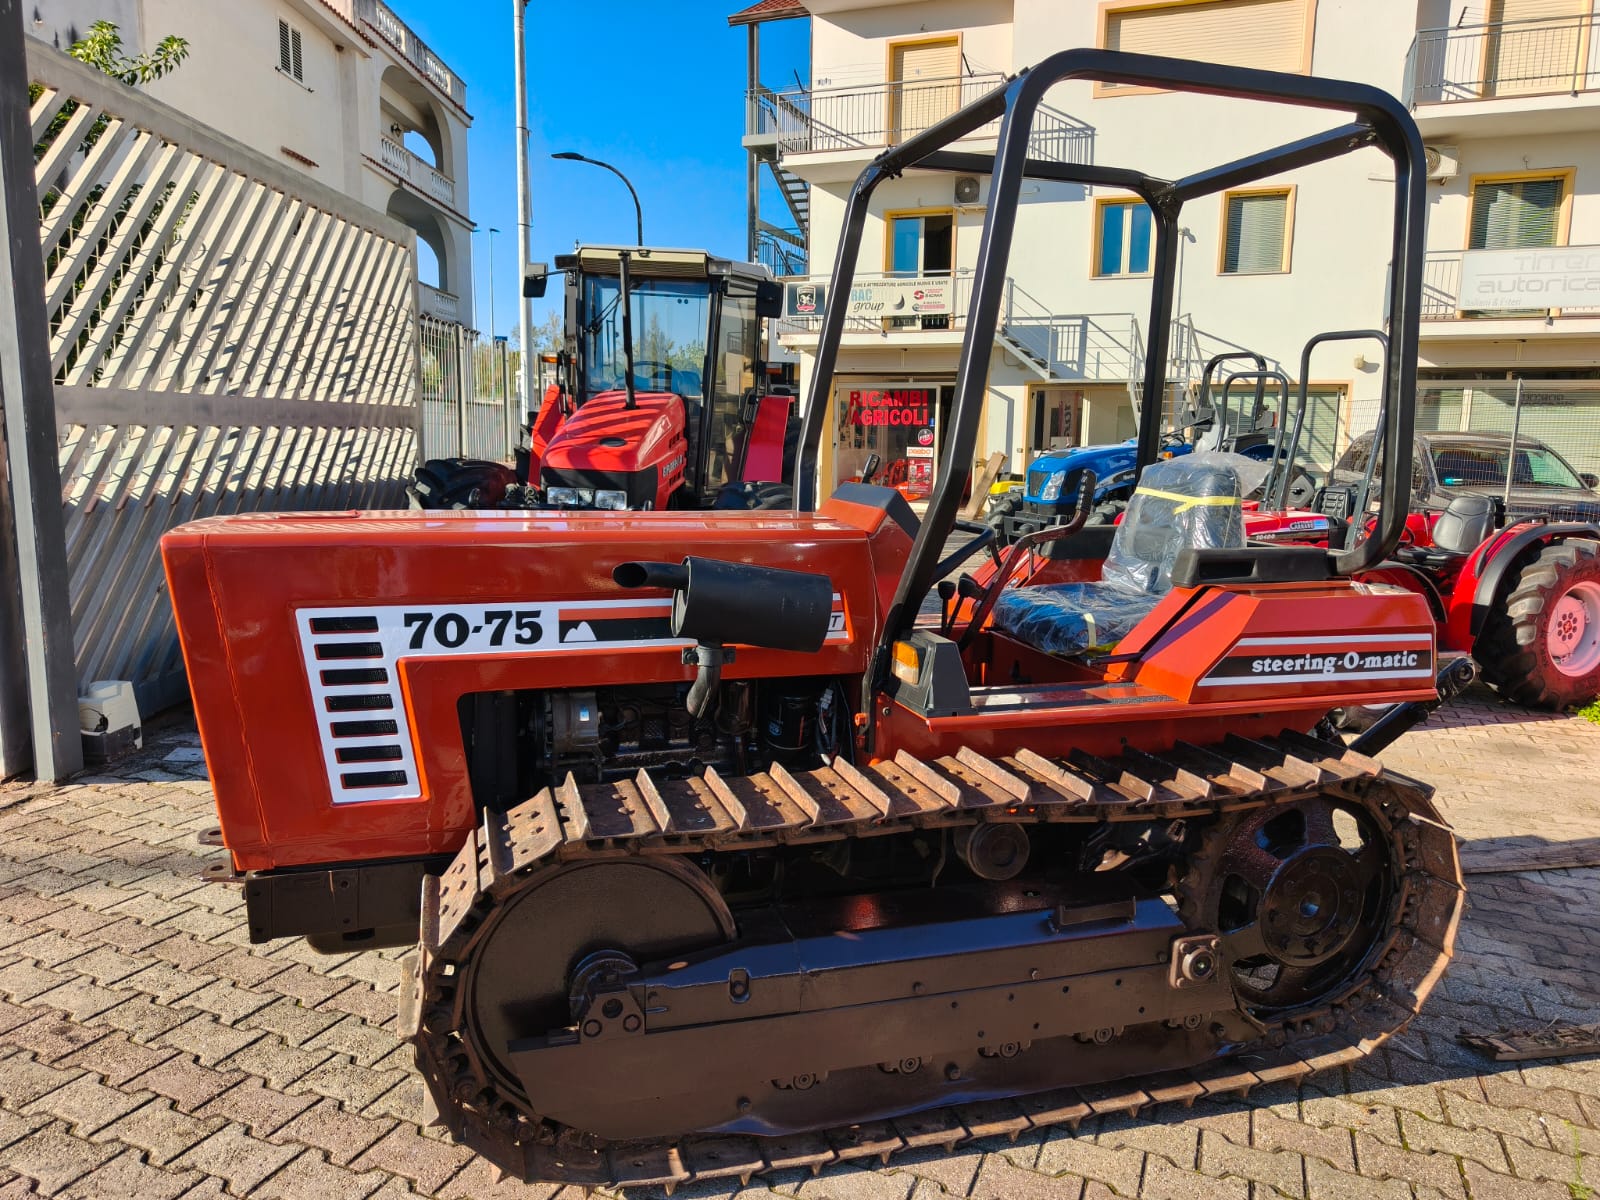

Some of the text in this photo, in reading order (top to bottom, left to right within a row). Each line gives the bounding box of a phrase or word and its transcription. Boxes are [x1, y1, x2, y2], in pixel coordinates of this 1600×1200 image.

[853, 301, 884, 312] group
[850, 390, 928, 407] RICAMBI
[851, 409, 928, 426] AGRICOLI
[403, 609, 543, 650] 70-75
[1251, 651, 1418, 675] steering-O-matic
